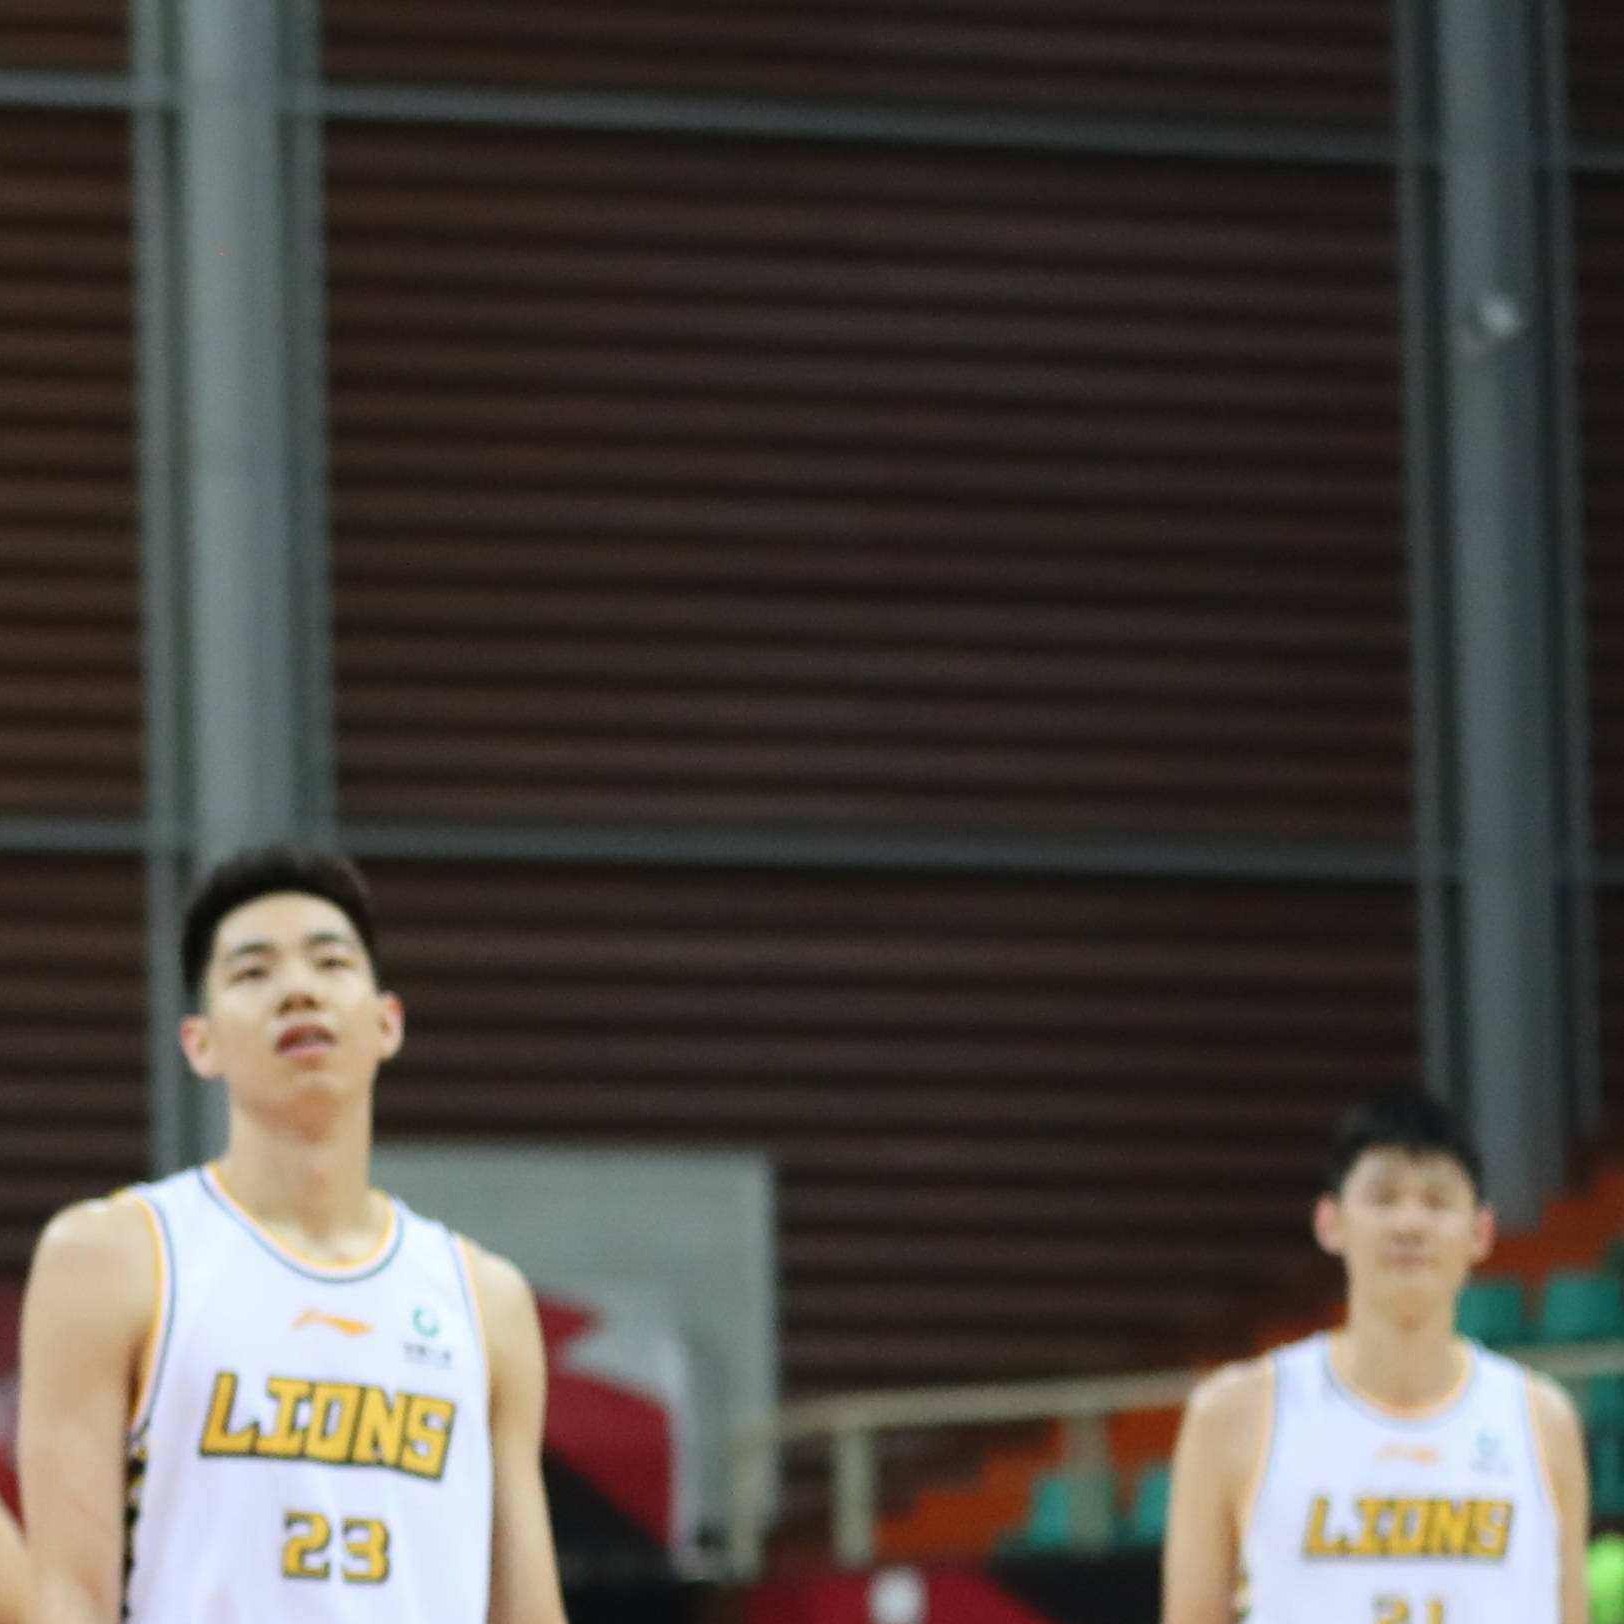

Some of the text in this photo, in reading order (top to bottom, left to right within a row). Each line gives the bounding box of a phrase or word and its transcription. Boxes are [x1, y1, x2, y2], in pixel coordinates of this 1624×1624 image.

[198, 1370, 456, 1482] LIONS
[282, 1509, 391, 1584] 23
[1304, 1494, 1514, 1562] LIONS
